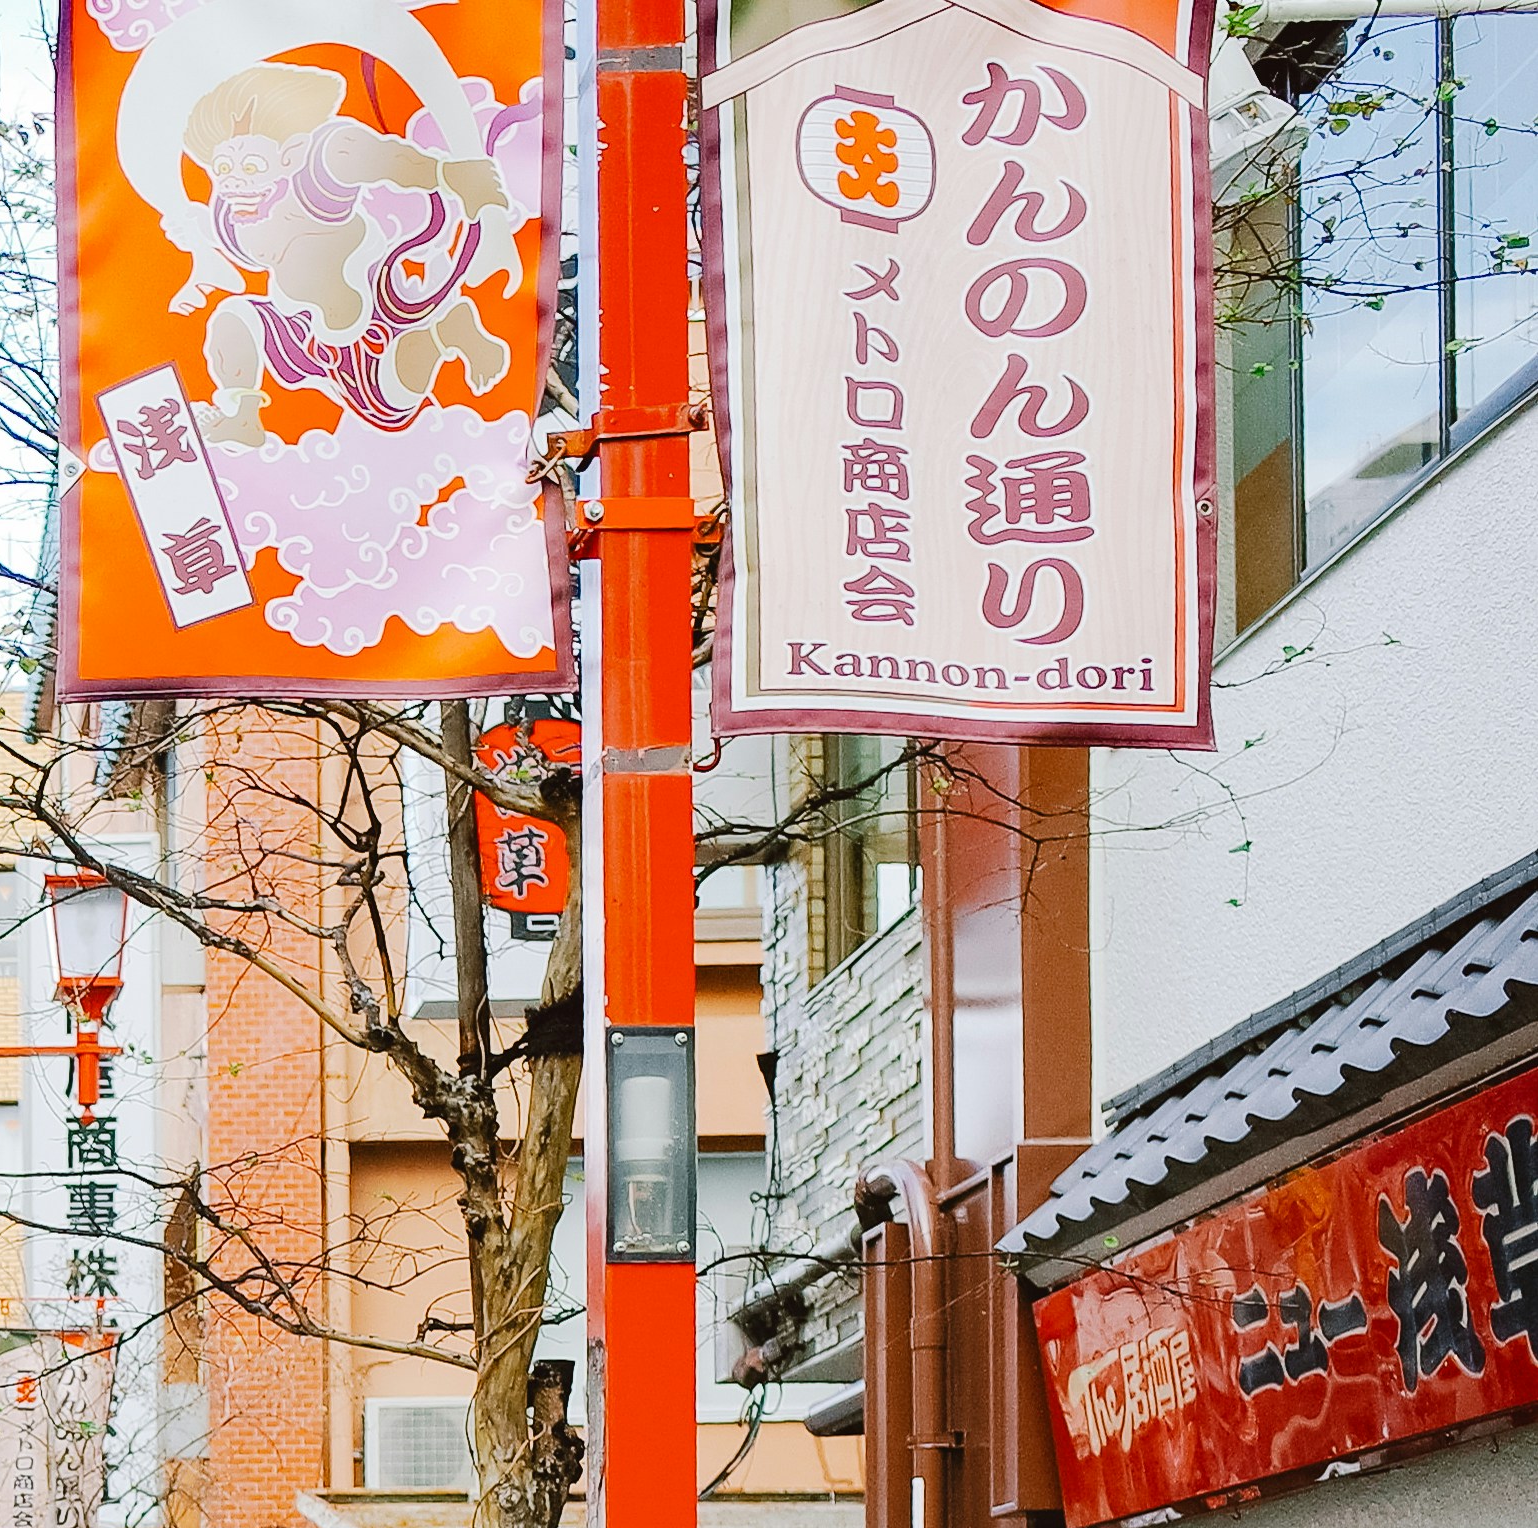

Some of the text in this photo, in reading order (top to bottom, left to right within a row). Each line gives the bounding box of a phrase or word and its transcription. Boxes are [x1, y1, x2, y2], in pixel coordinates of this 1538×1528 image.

[841, 256, 916, 628] メトロ商店会
[961, 61, 1095, 646] かんのん通り
[114, 398, 240, 599] 浅草
[785, 641, 1158, 694] Kannon-dori
